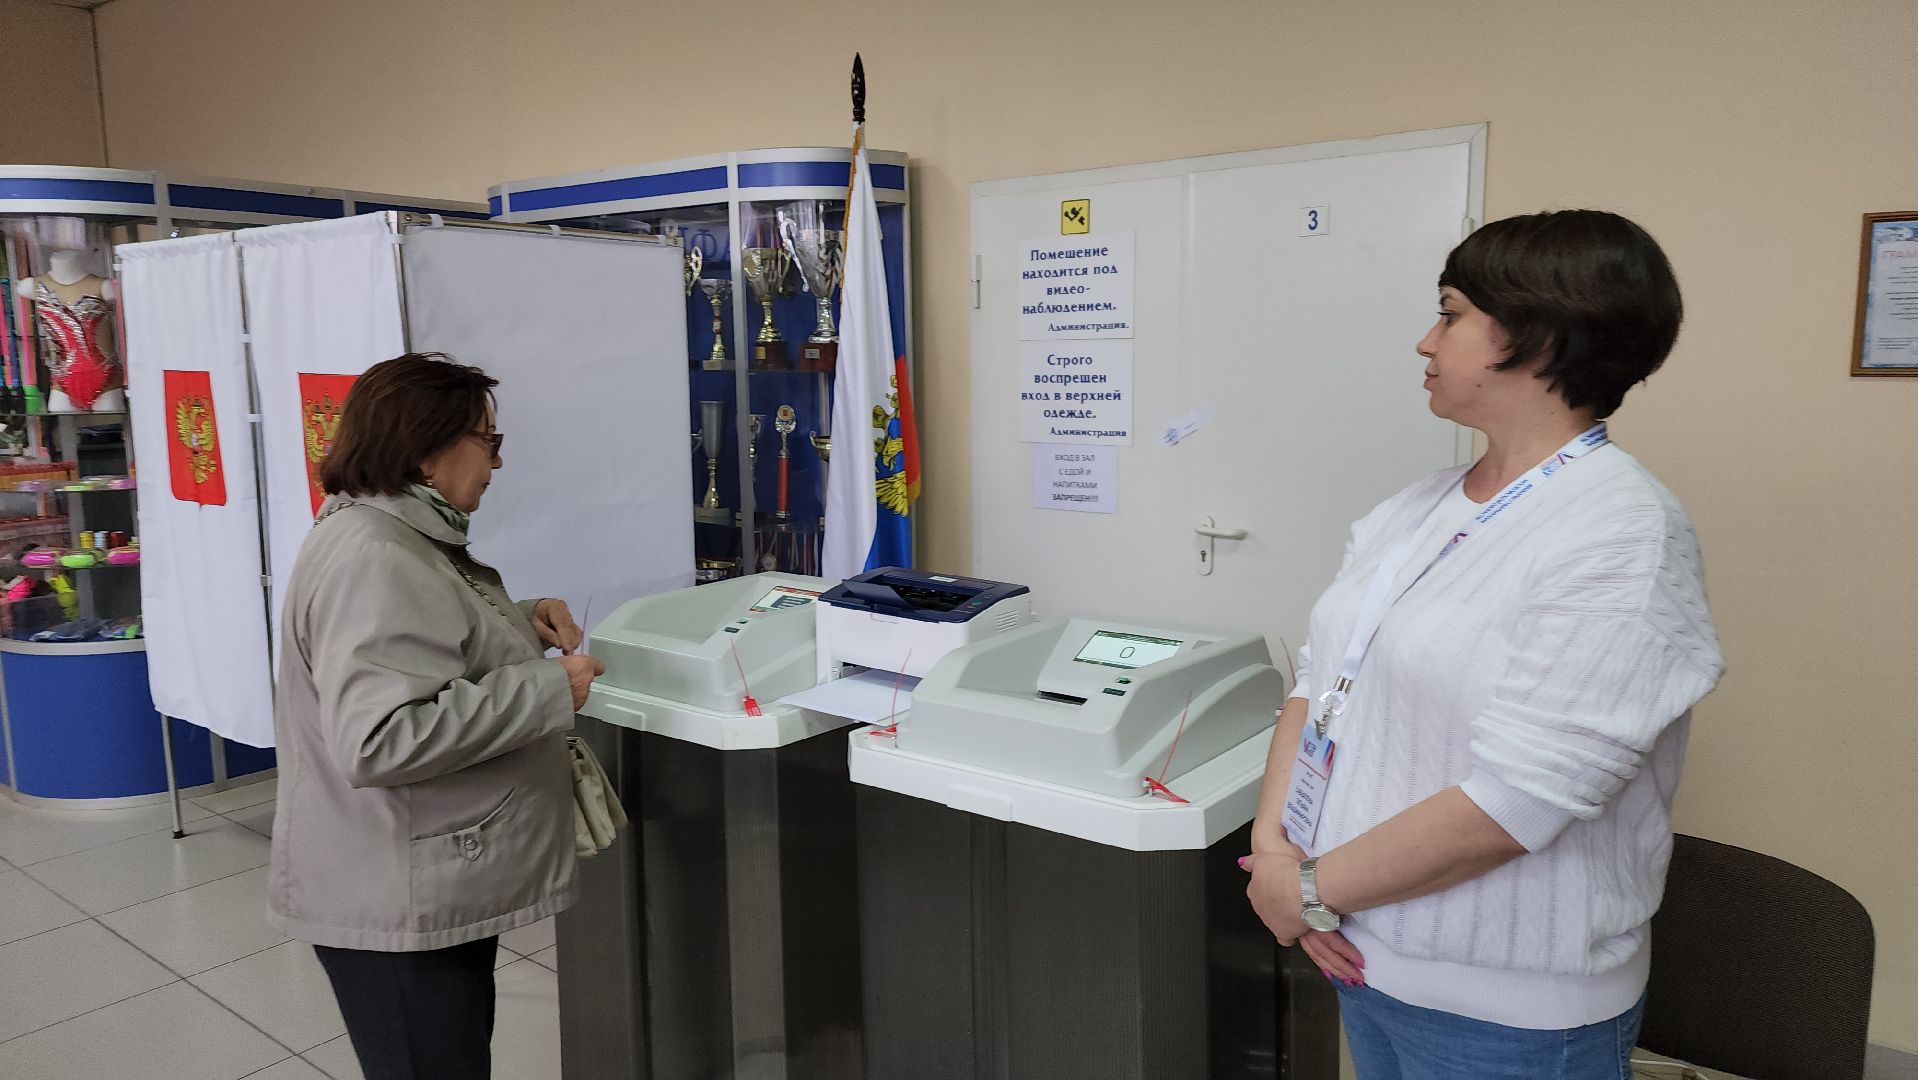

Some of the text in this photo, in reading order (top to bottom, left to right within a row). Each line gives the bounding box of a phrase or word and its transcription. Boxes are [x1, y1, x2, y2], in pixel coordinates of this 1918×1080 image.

[1308, 210, 1318, 230] 3
[1022, 265, 1119, 280] находится под
[1046, 285, 1091, 296] видео-
[1022, 302, 1117, 315] наблюдением.
[1047, 354, 1093, 369] Строго
[1021, 389, 1122, 404] вход в верхней
[1043, 409, 1097, 419] одежде.
[1120, 646, 1136, 659] 0
